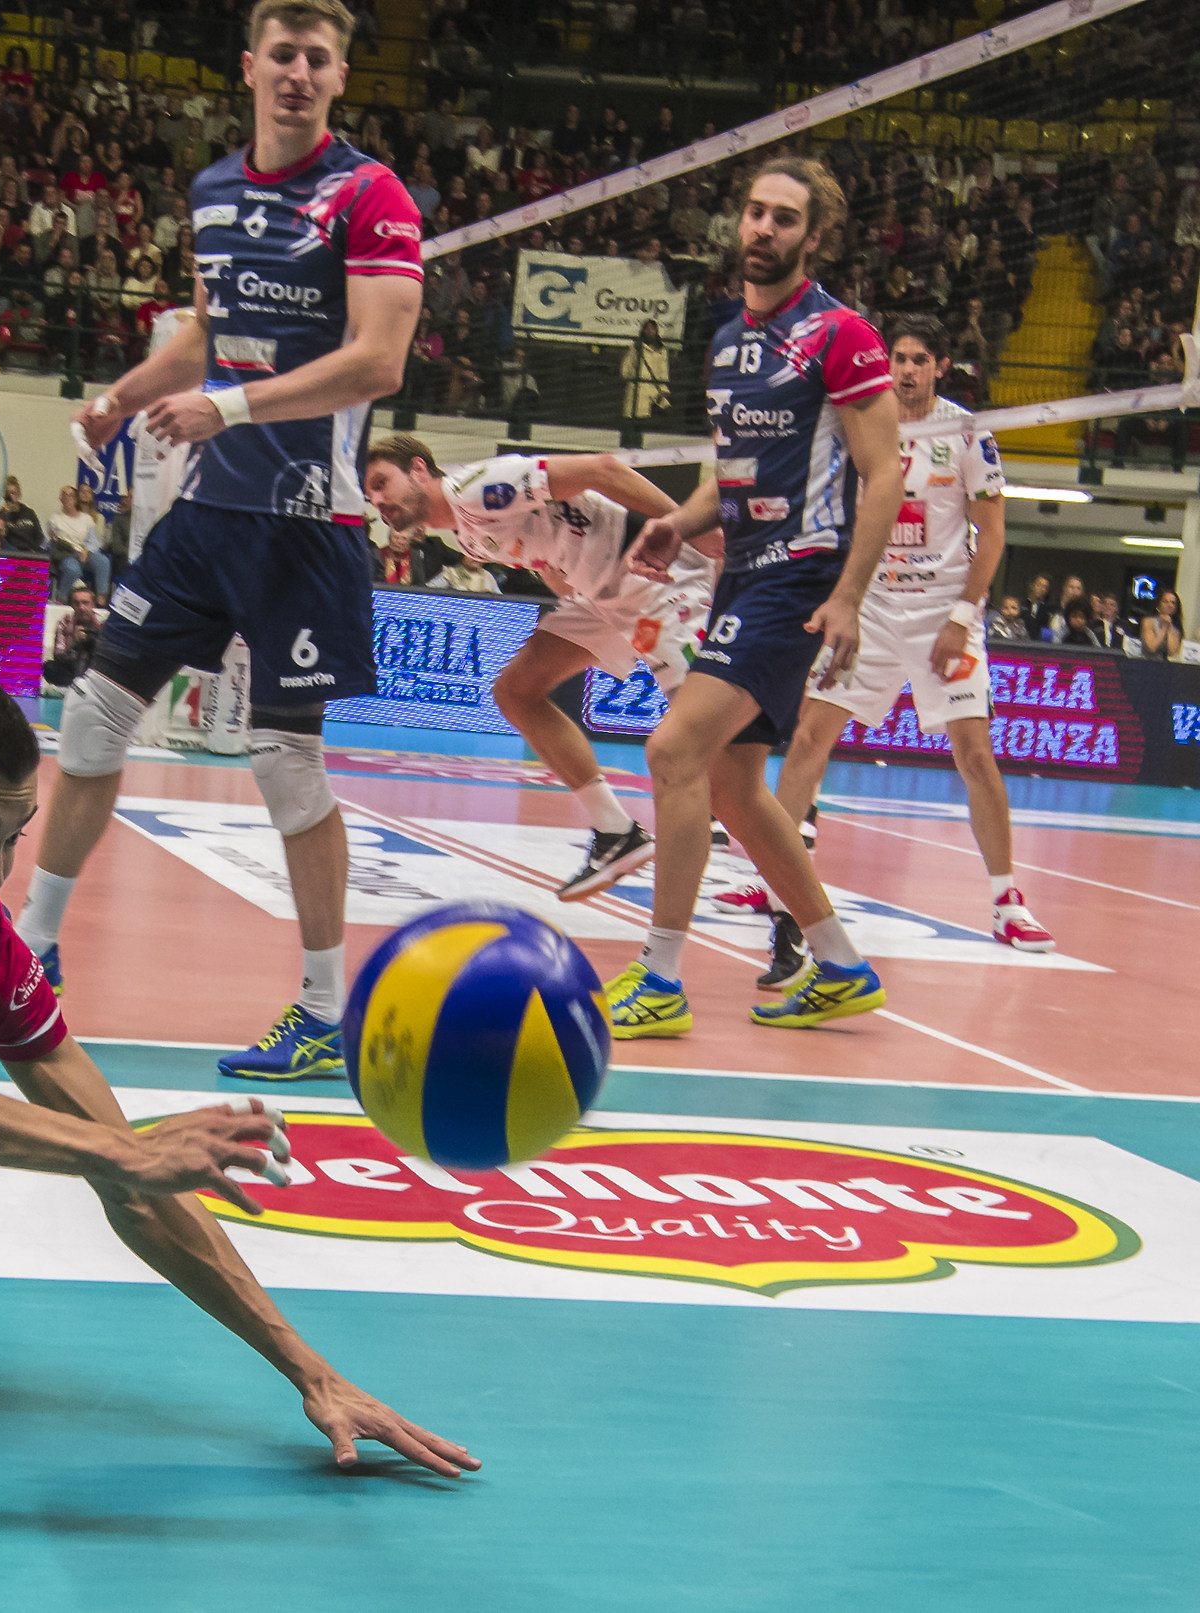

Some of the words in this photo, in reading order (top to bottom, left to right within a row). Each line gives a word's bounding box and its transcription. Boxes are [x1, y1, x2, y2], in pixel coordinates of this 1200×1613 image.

[242, 205, 268, 238] 6
[237, 271, 321, 308] Group
[595, 288, 669, 320] Group
[739, 341, 763, 374] 13
[732, 402, 795, 429] Group
[708, 614, 742, 645] 13
[291, 628, 319, 669] 6
[279, 671, 336, 688] macron
[990, 663, 1095, 710] ELLA
[462, 1200, 863, 1253] Quality
